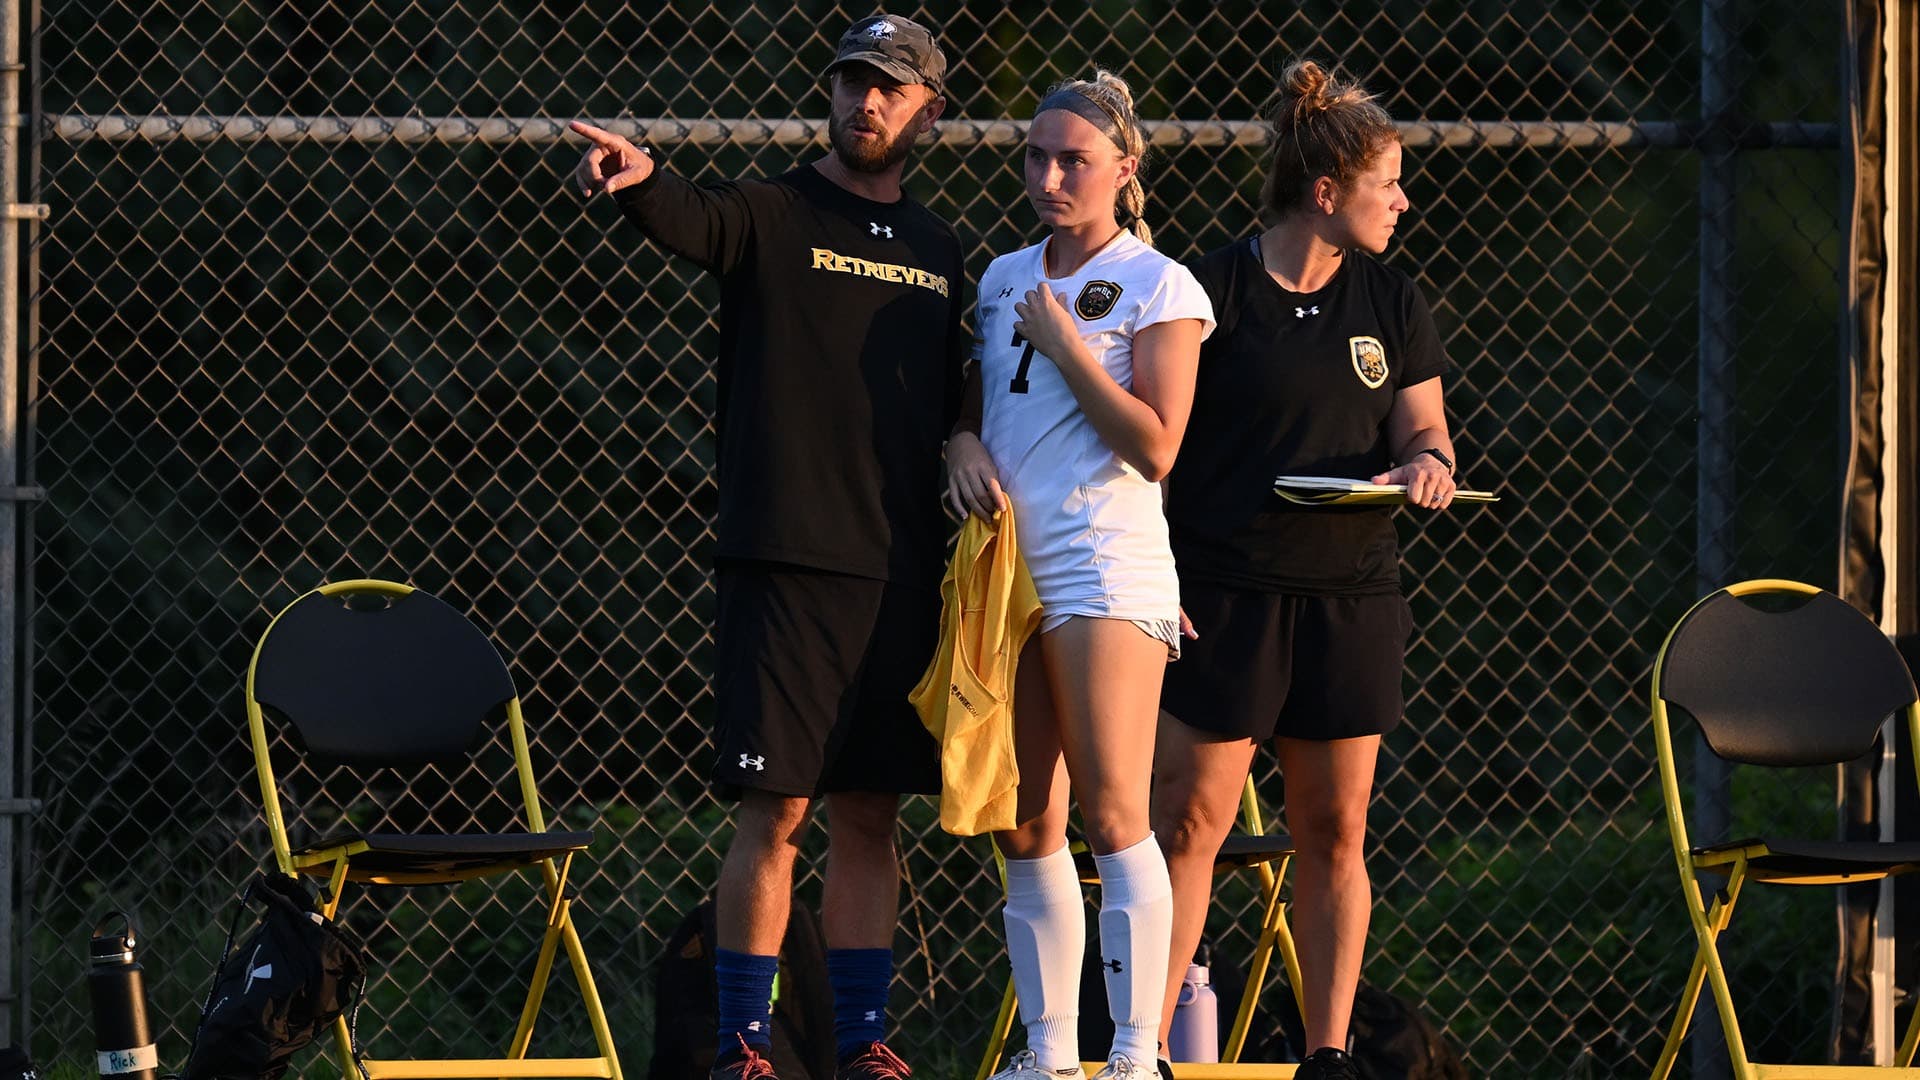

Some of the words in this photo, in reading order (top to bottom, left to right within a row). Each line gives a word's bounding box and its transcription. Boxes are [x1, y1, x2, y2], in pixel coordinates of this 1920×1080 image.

[811, 247, 949, 298] RETRIEVERS
[1010, 330, 1035, 394] 7
[109, 1052, 136, 1070] Rick
